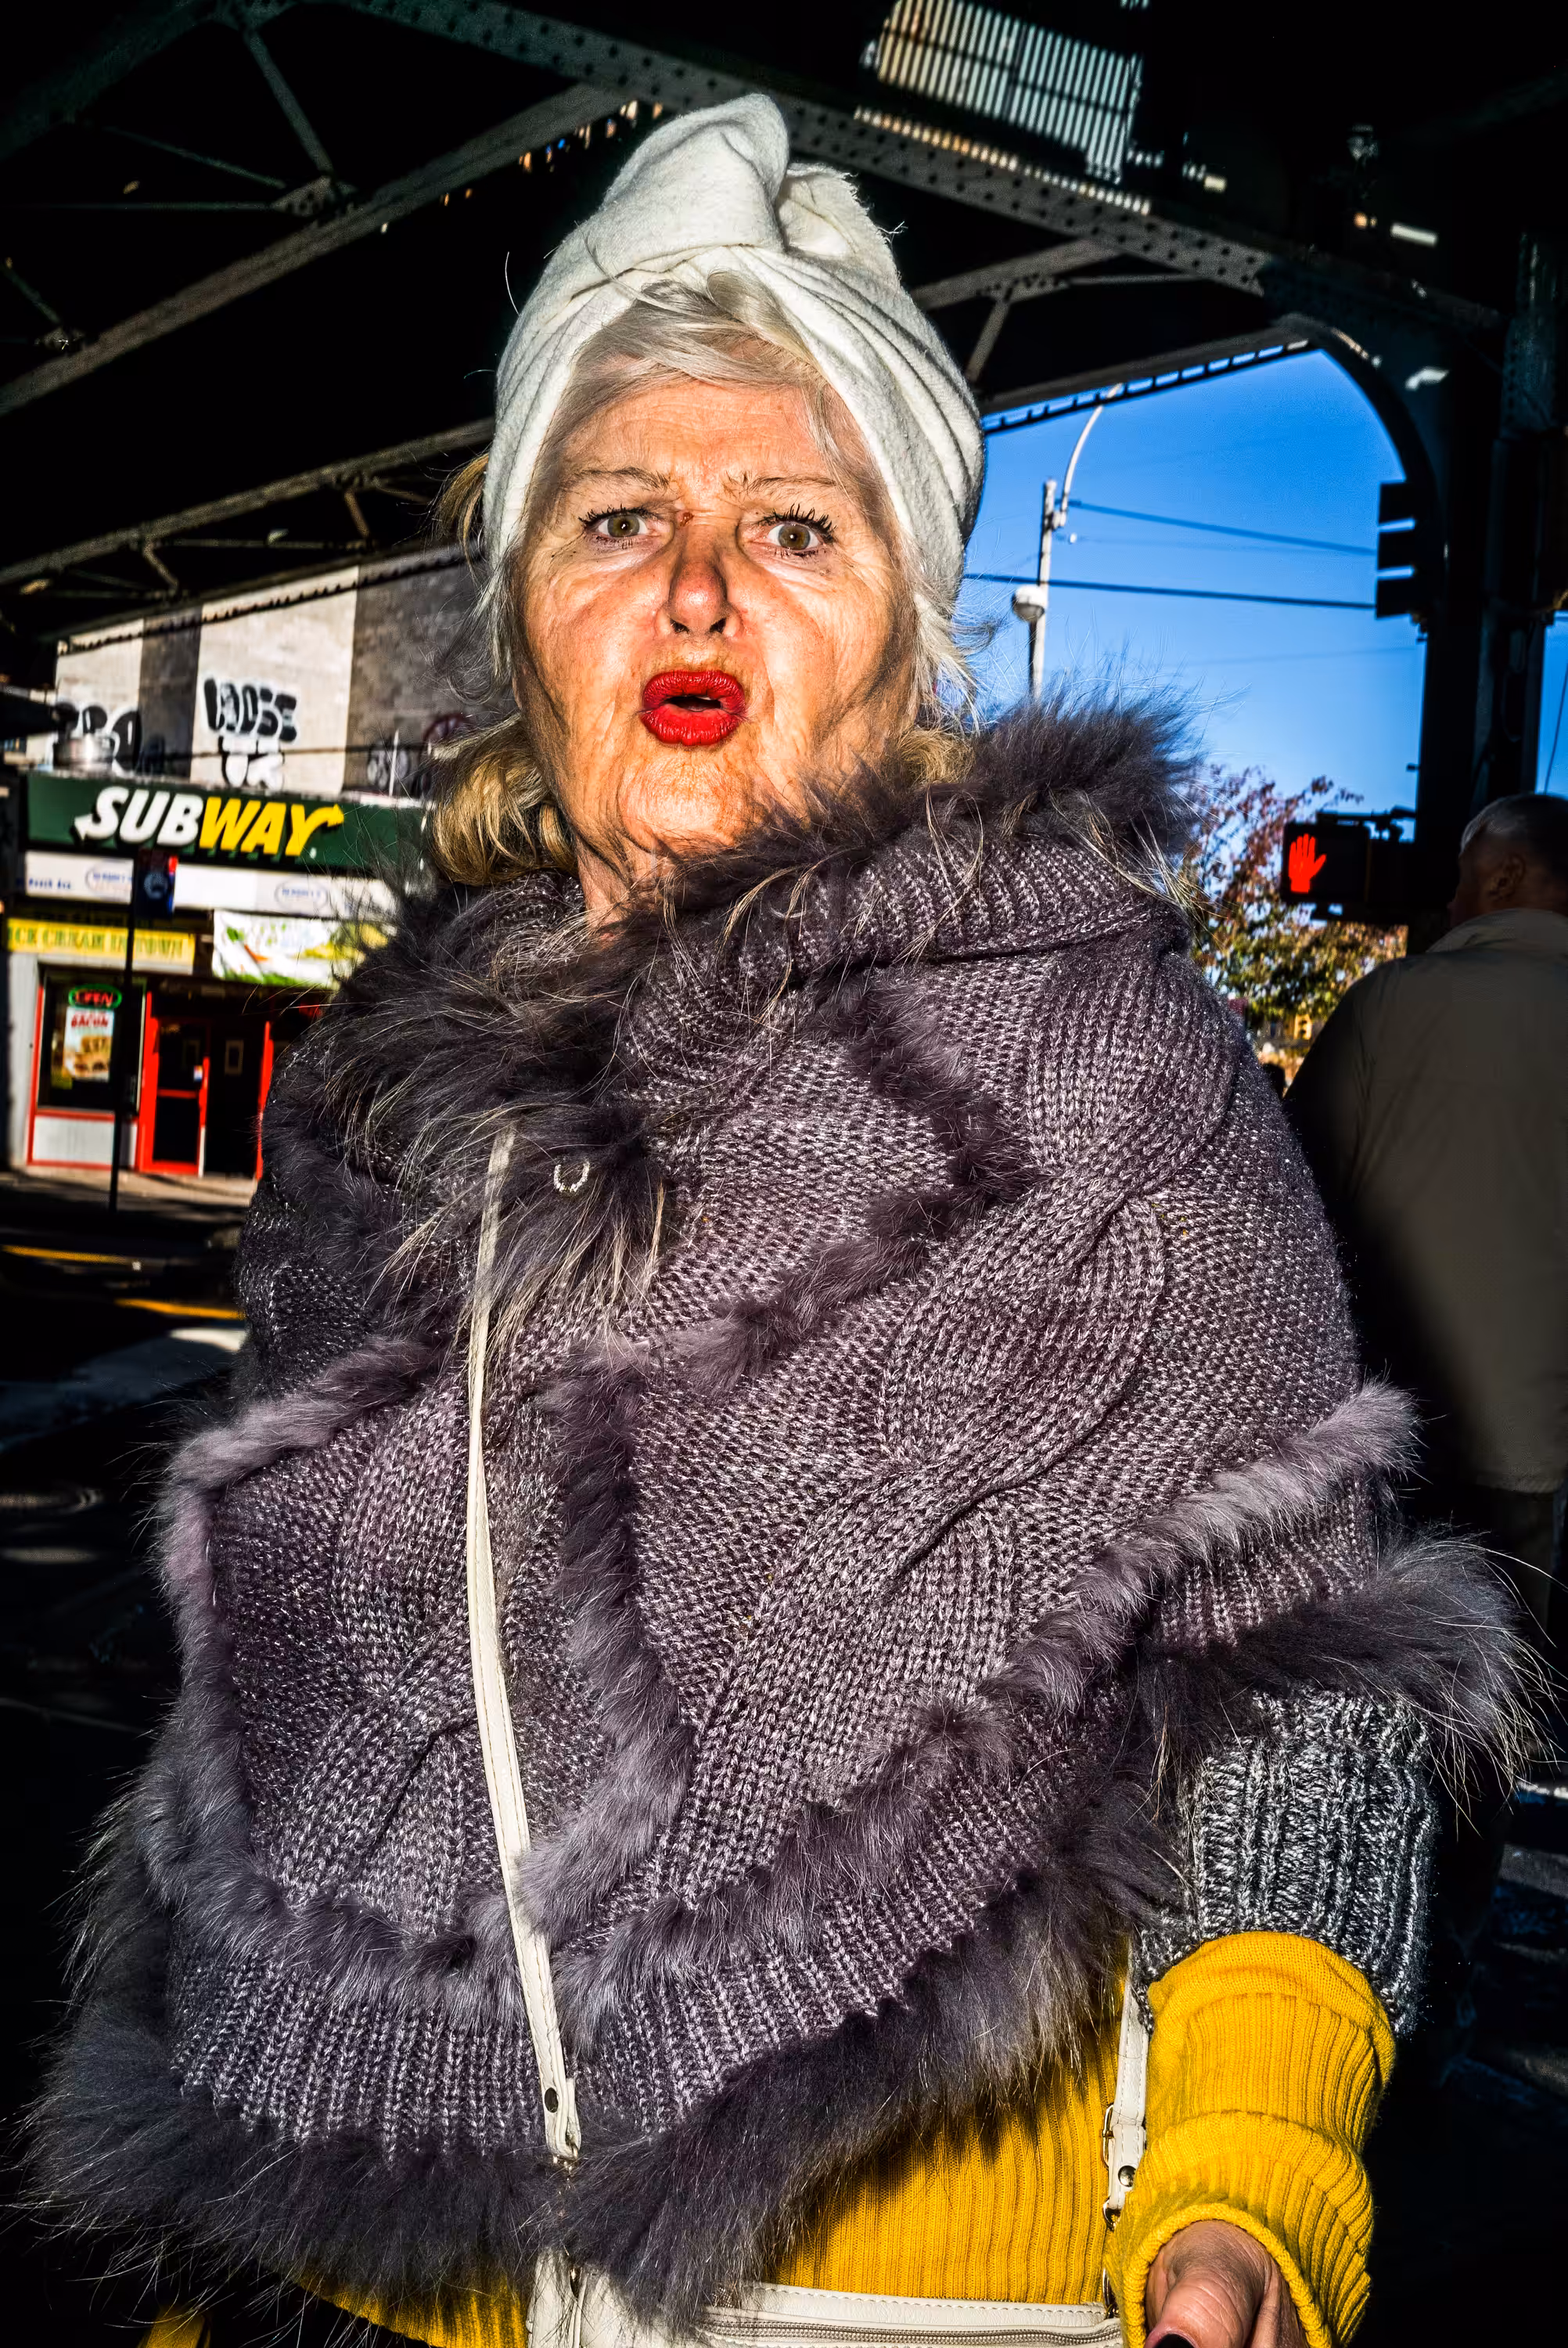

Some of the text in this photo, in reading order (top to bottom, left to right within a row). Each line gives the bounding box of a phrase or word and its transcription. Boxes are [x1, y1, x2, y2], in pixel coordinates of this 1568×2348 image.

[74, 786, 344, 856] SUBWAY
[41, 927, 105, 953] CREAM
[74, 989, 113, 1007] OPEN
